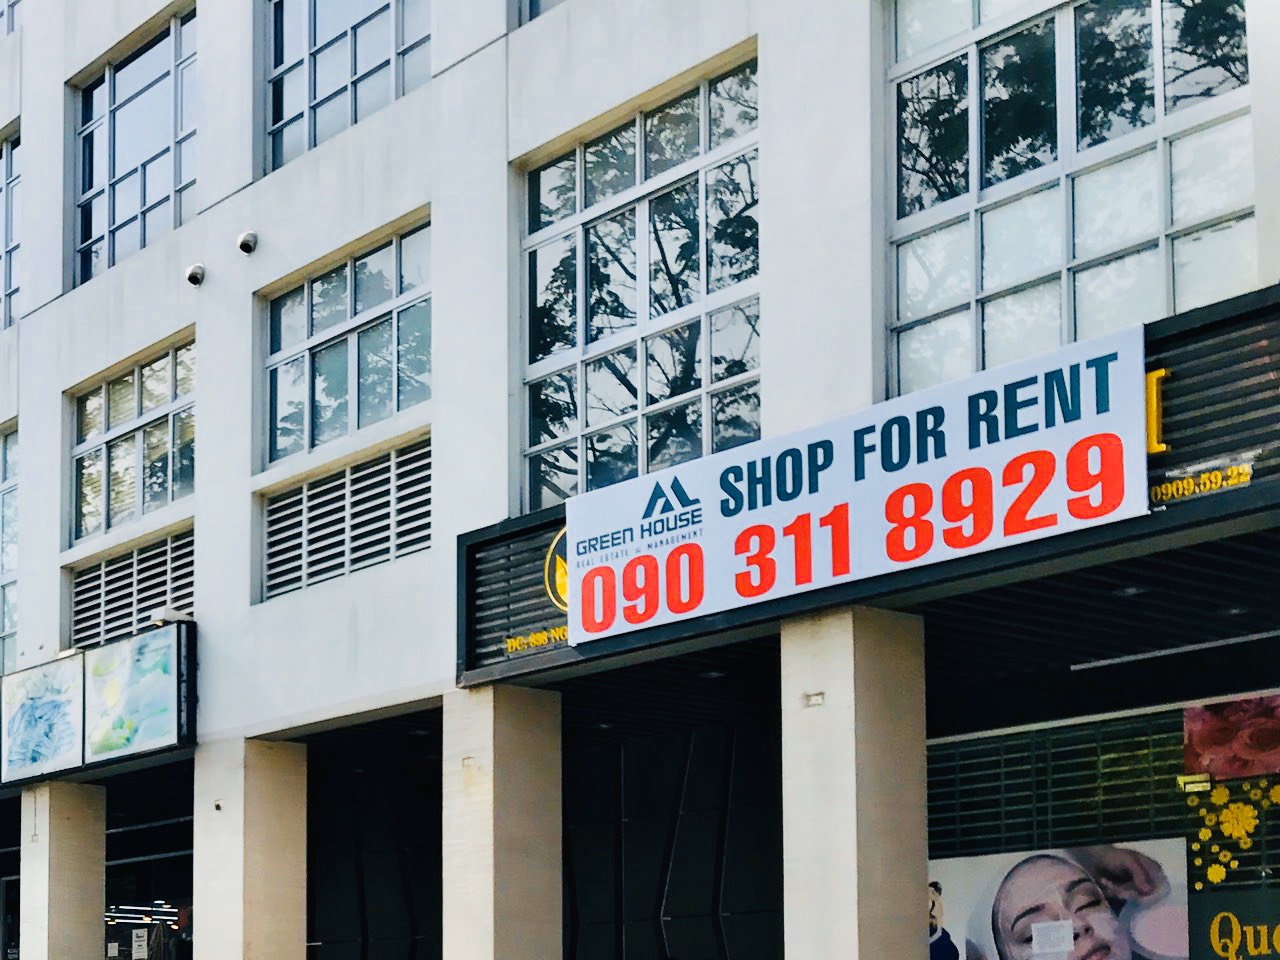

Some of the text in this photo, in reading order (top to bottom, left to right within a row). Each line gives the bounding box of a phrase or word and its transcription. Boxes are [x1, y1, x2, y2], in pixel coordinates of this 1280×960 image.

[719, 439, 834, 518] SHOP
[853, 405, 948, 482] FOR
[967, 351, 1119, 450] RENT
[576, 508, 703, 556] GREEN HOUSE
[576, 557, 595, 569] REAL
[600, 550, 629, 563] ESTATE
[647, 528, 703, 550] MANAGEMENT
[581, 432, 1125, 634] 090 311 8929
